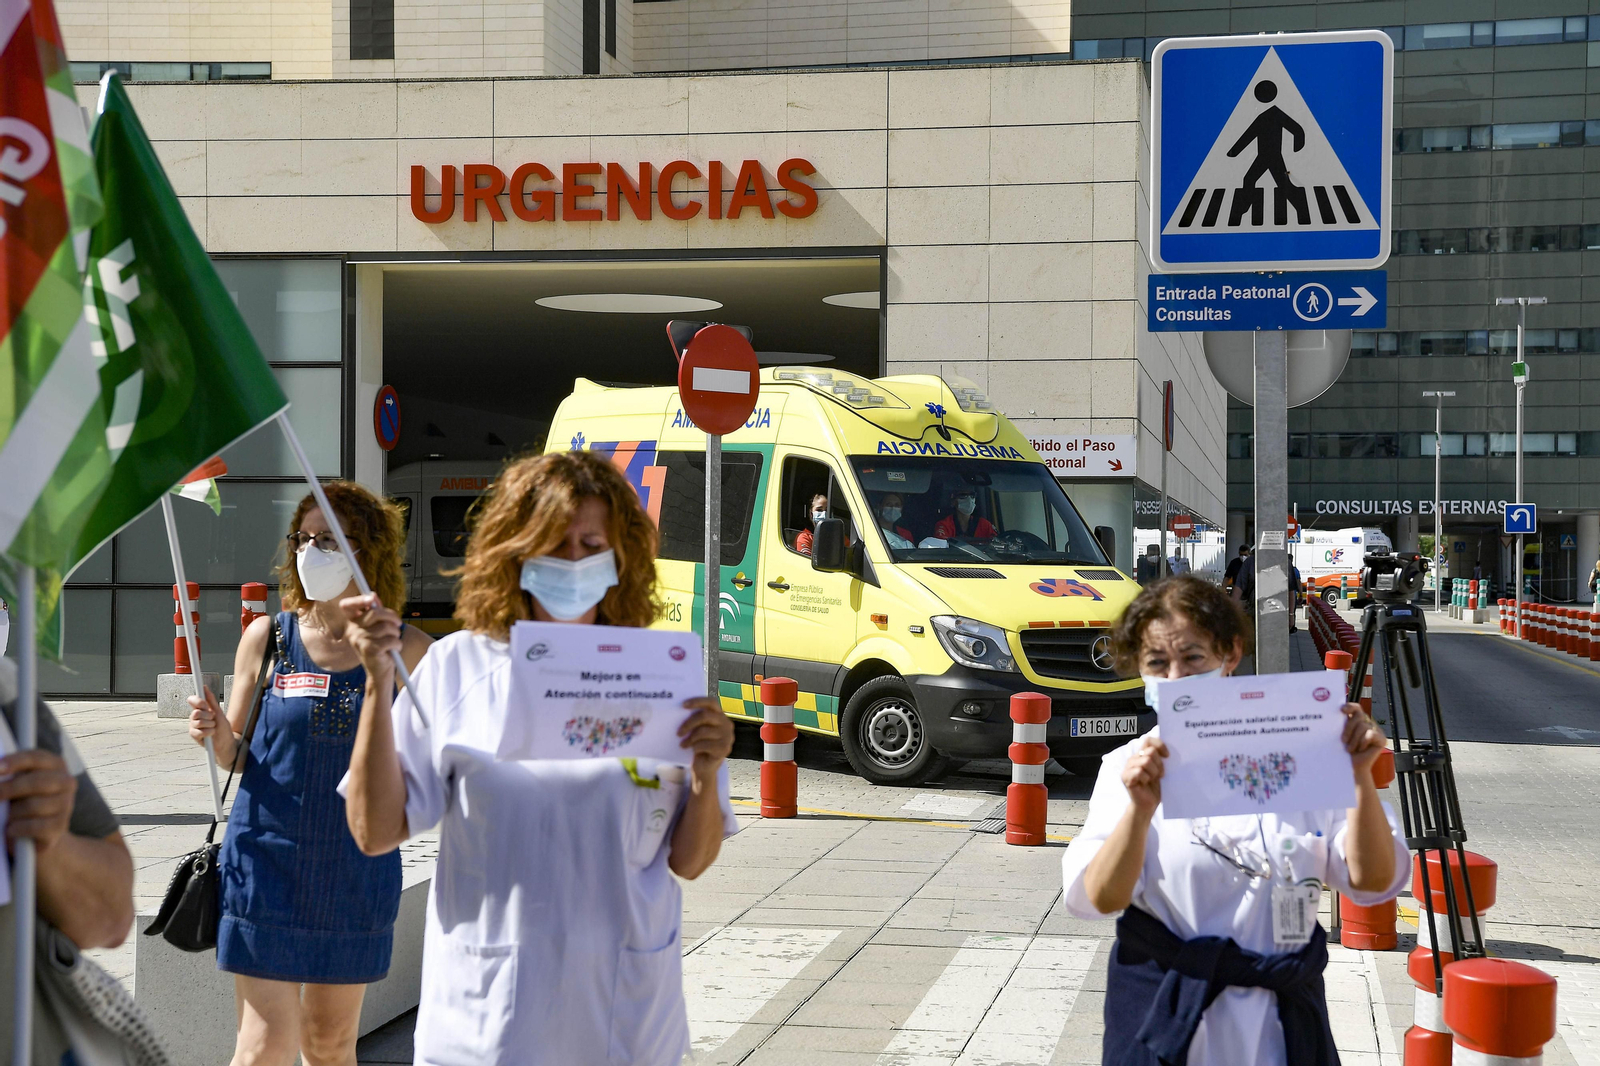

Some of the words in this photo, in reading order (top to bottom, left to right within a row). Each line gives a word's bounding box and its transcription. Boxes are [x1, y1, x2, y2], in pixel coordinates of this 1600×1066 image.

[410, 158, 819, 224] URGENCIAS
[1155, 286, 1217, 301] Entrada
[1222, 284, 1291, 299] Peatonal
[1155, 307, 1232, 321] Consultas
[1066, 439, 1078, 451] el
[1083, 439, 1116, 452] Paso
[1045, 456, 1086, 468] atonal
[1315, 500, 1413, 515] CONSULTAS
[1418, 500, 1508, 515] EXTERNAS
[791, 584, 808, 593] Empresa
[790, 594, 795, 602] de
[796, 594, 822, 605] Emergencias
[822, 596, 842, 606] Sanitarias
[580, 671, 622, 684] Mejora
[626, 674, 641, 682] en
[545, 689, 601, 699] Atención
[605, 689, 673, 699] continuada
[1080, 719, 1111, 734] 8160
[1115, 718, 1136, 733] KJN
[1185, 717, 1242, 729] Equiparación
[1245, 715, 1278, 725] salarial
[1280, 714, 1297, 722] con
[1299, 712, 1323, 721] otras
[1198, 728, 1257, 739] Comunidades
